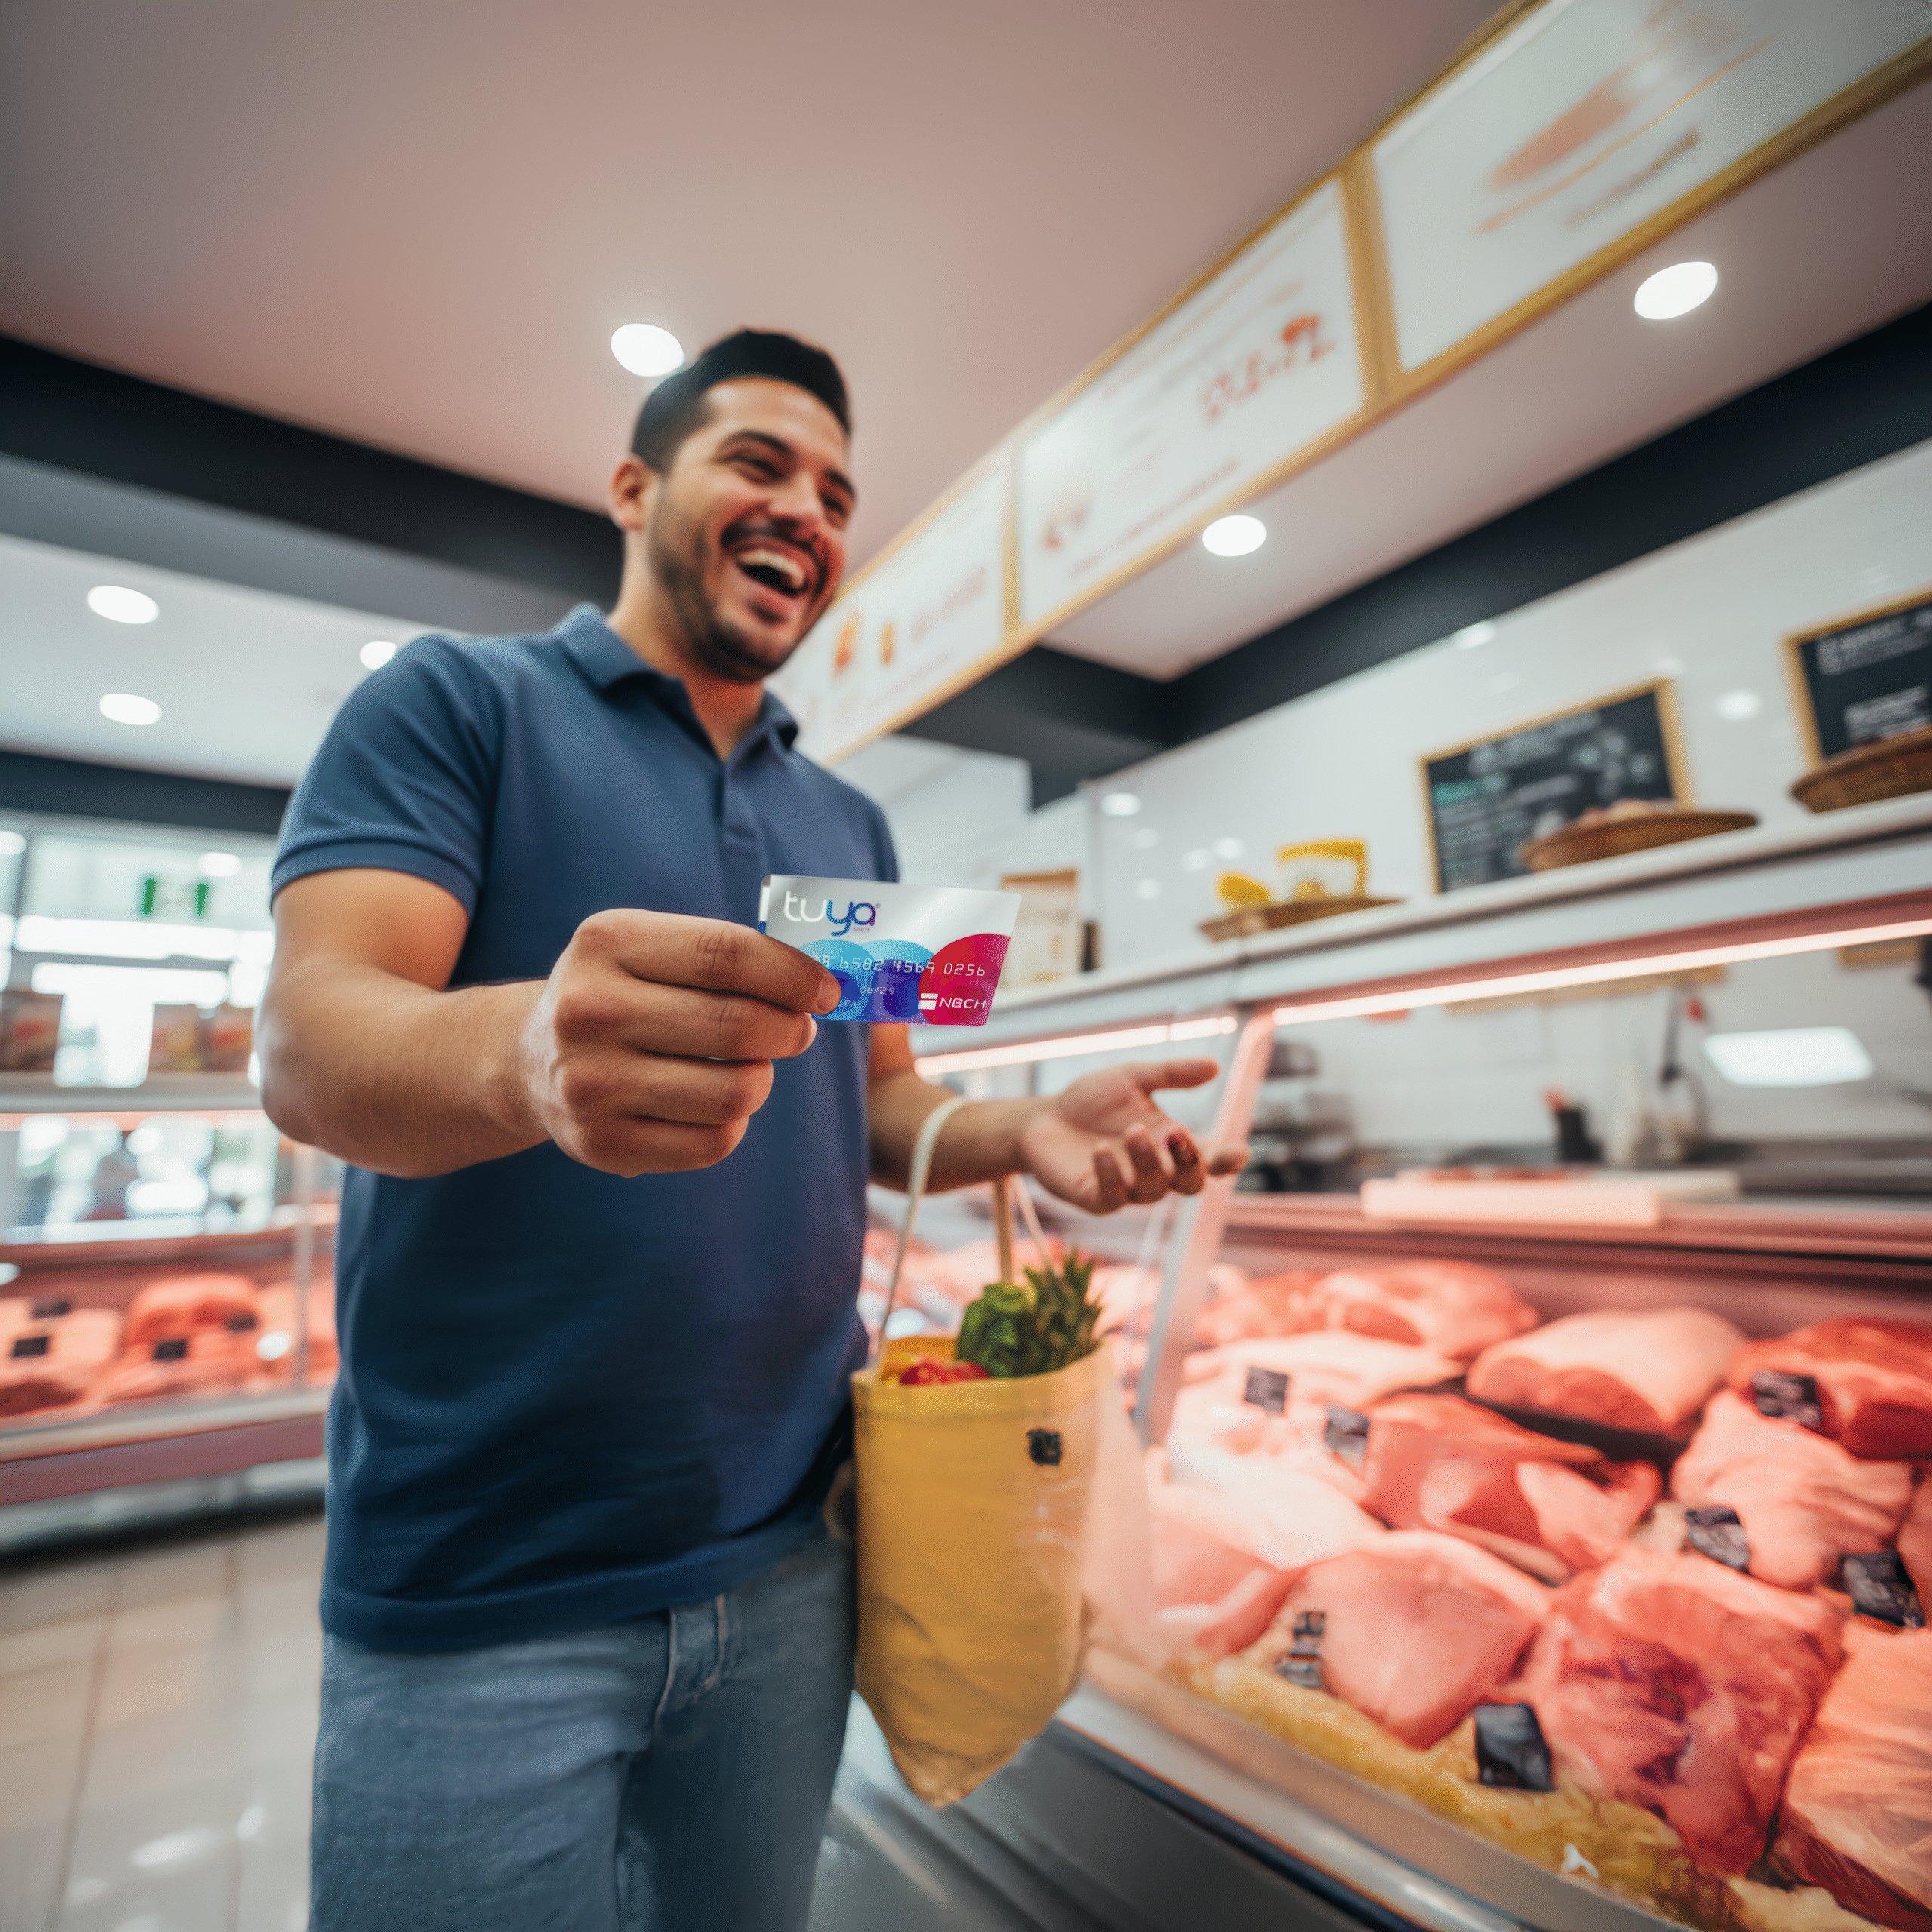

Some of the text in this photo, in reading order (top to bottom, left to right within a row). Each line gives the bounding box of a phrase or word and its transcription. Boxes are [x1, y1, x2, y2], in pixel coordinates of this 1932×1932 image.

[783, 891, 876, 937] tuya
[840, 956, 884, 971] 6582
[894, 960, 935, 974] 4569
[943, 962, 986, 976] 0256
[938, 997, 987, 1009] NBCH
